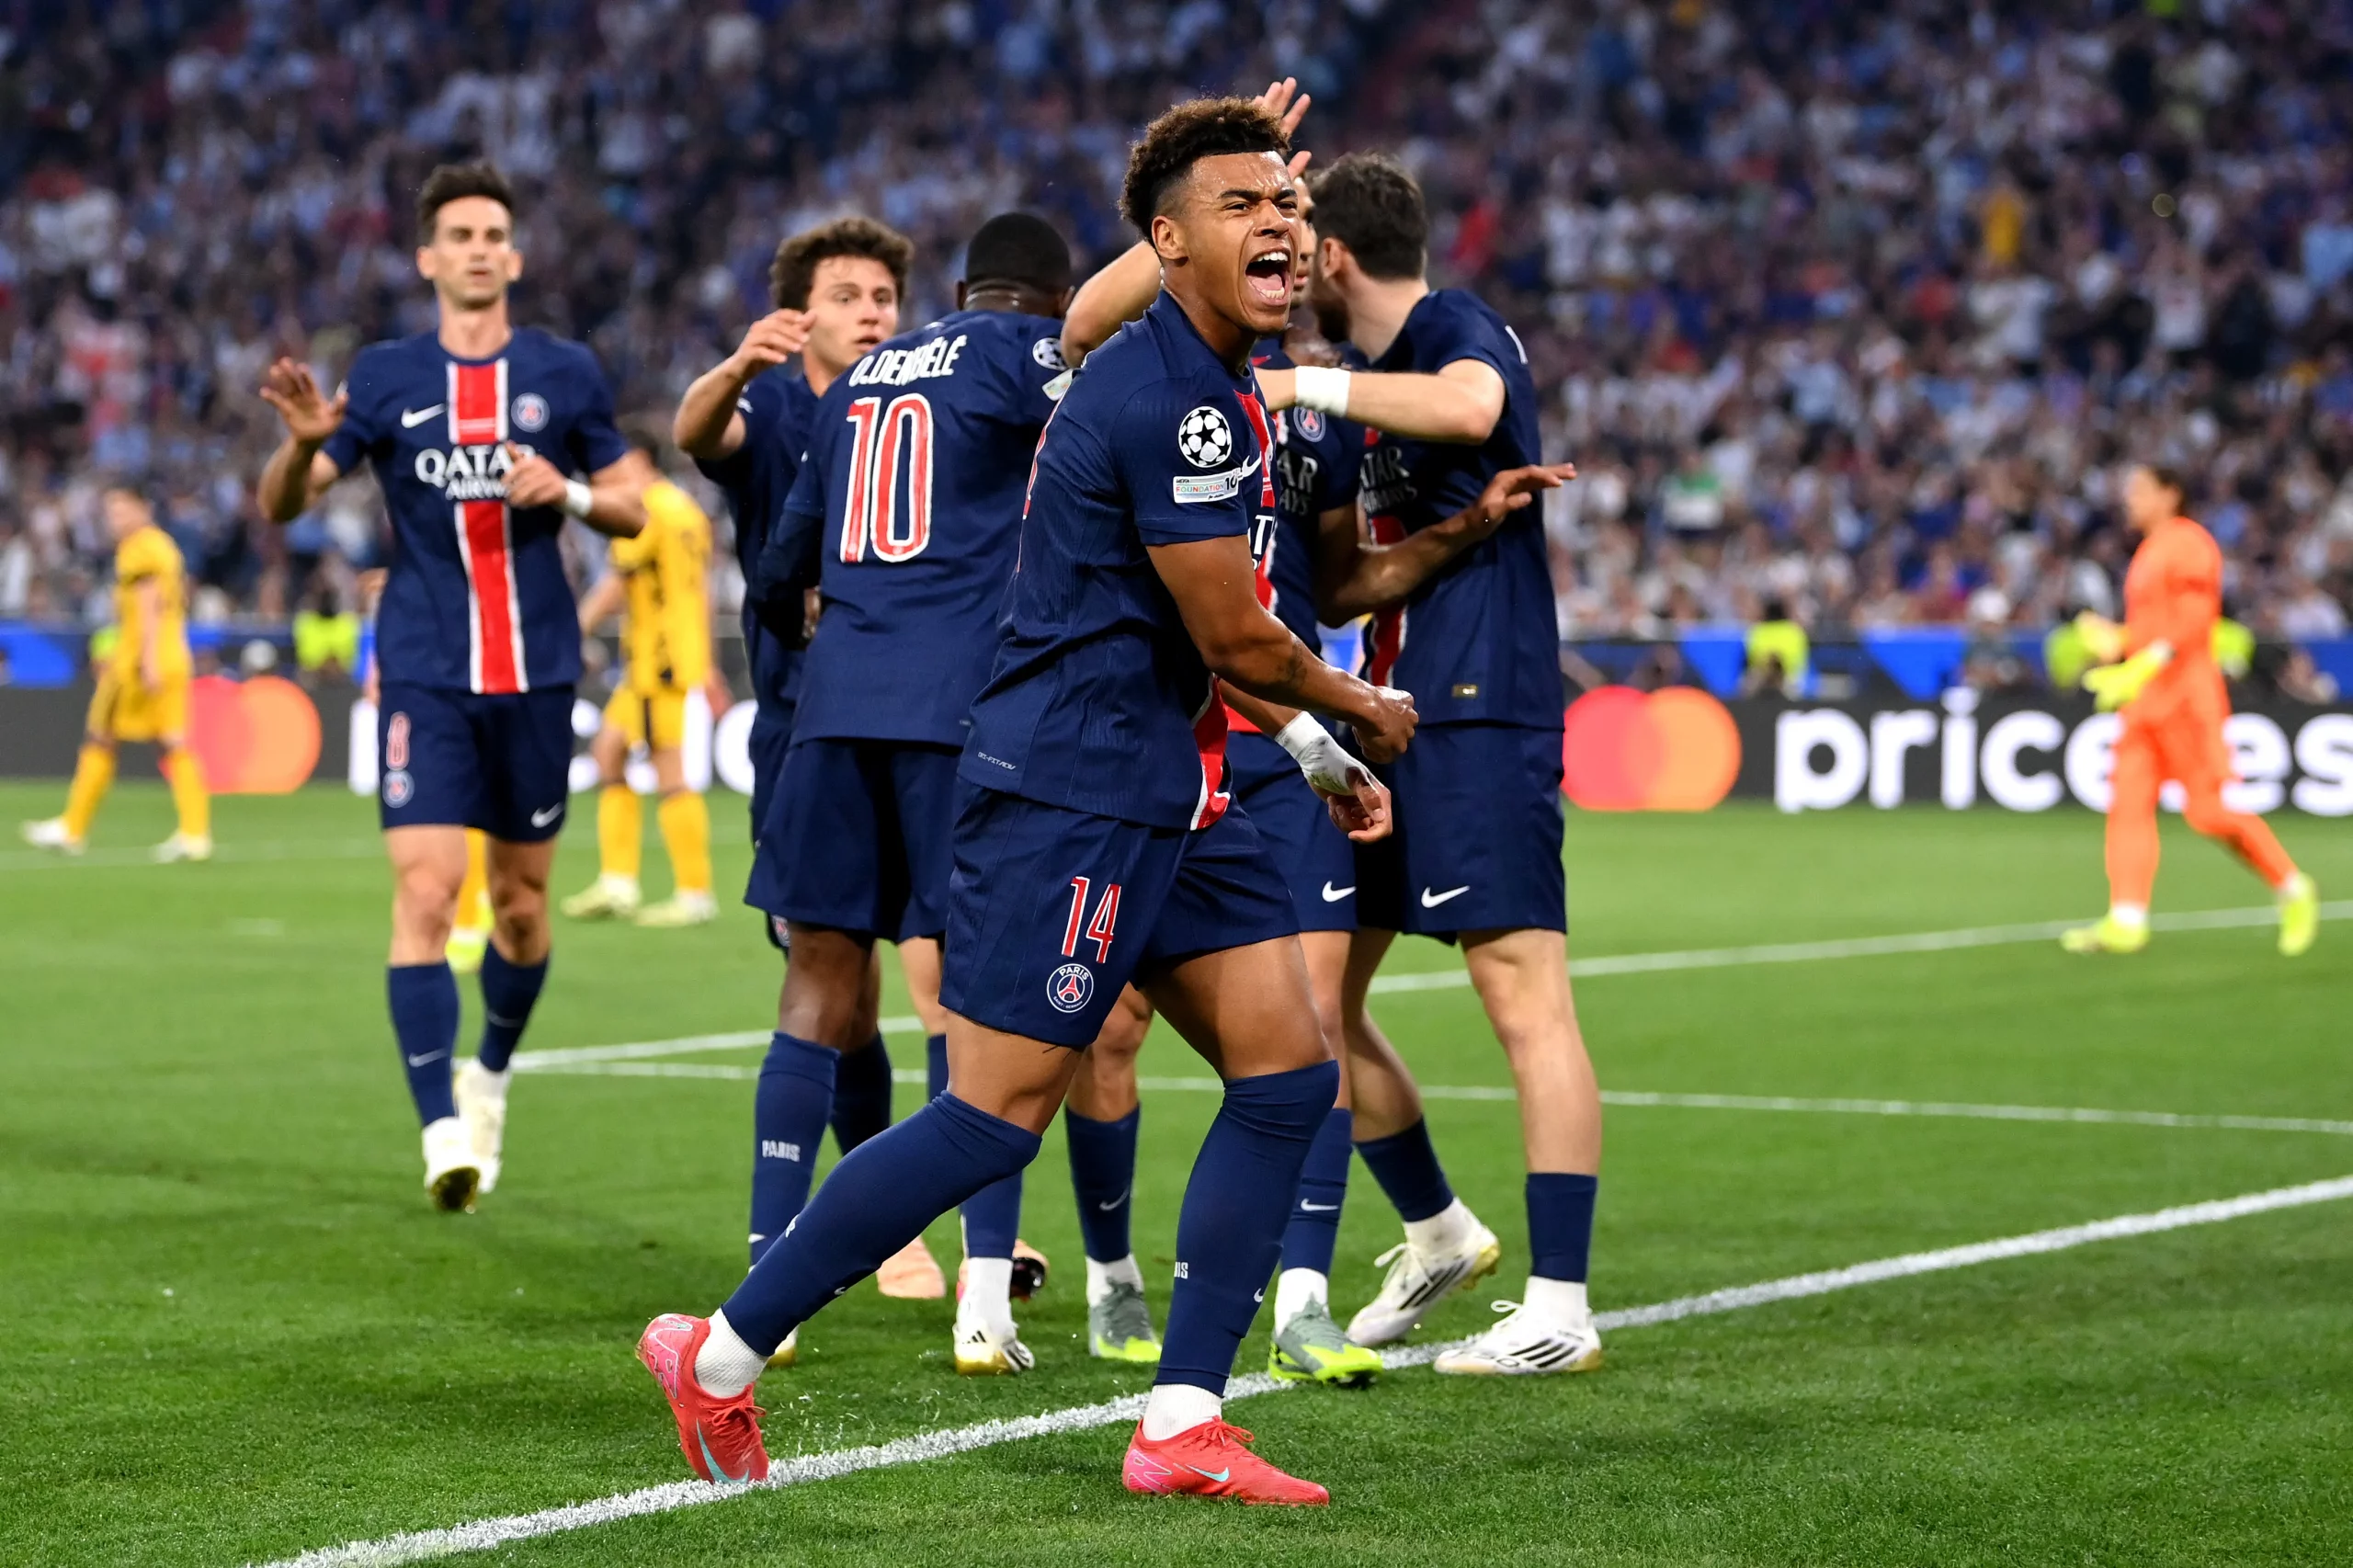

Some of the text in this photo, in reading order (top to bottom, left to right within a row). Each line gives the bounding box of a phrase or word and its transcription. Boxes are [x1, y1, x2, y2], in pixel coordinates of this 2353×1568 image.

[840, 393, 934, 563] 10
[1176, 483, 1224, 493] FOUNDATION
[1360, 447, 1411, 488] TAR
[1775, 687, 2353, 816] pricees
[1062, 876, 1121, 963] 14
[1059, 966, 1089, 981] PARIS
[761, 1139, 801, 1163] PARIS
